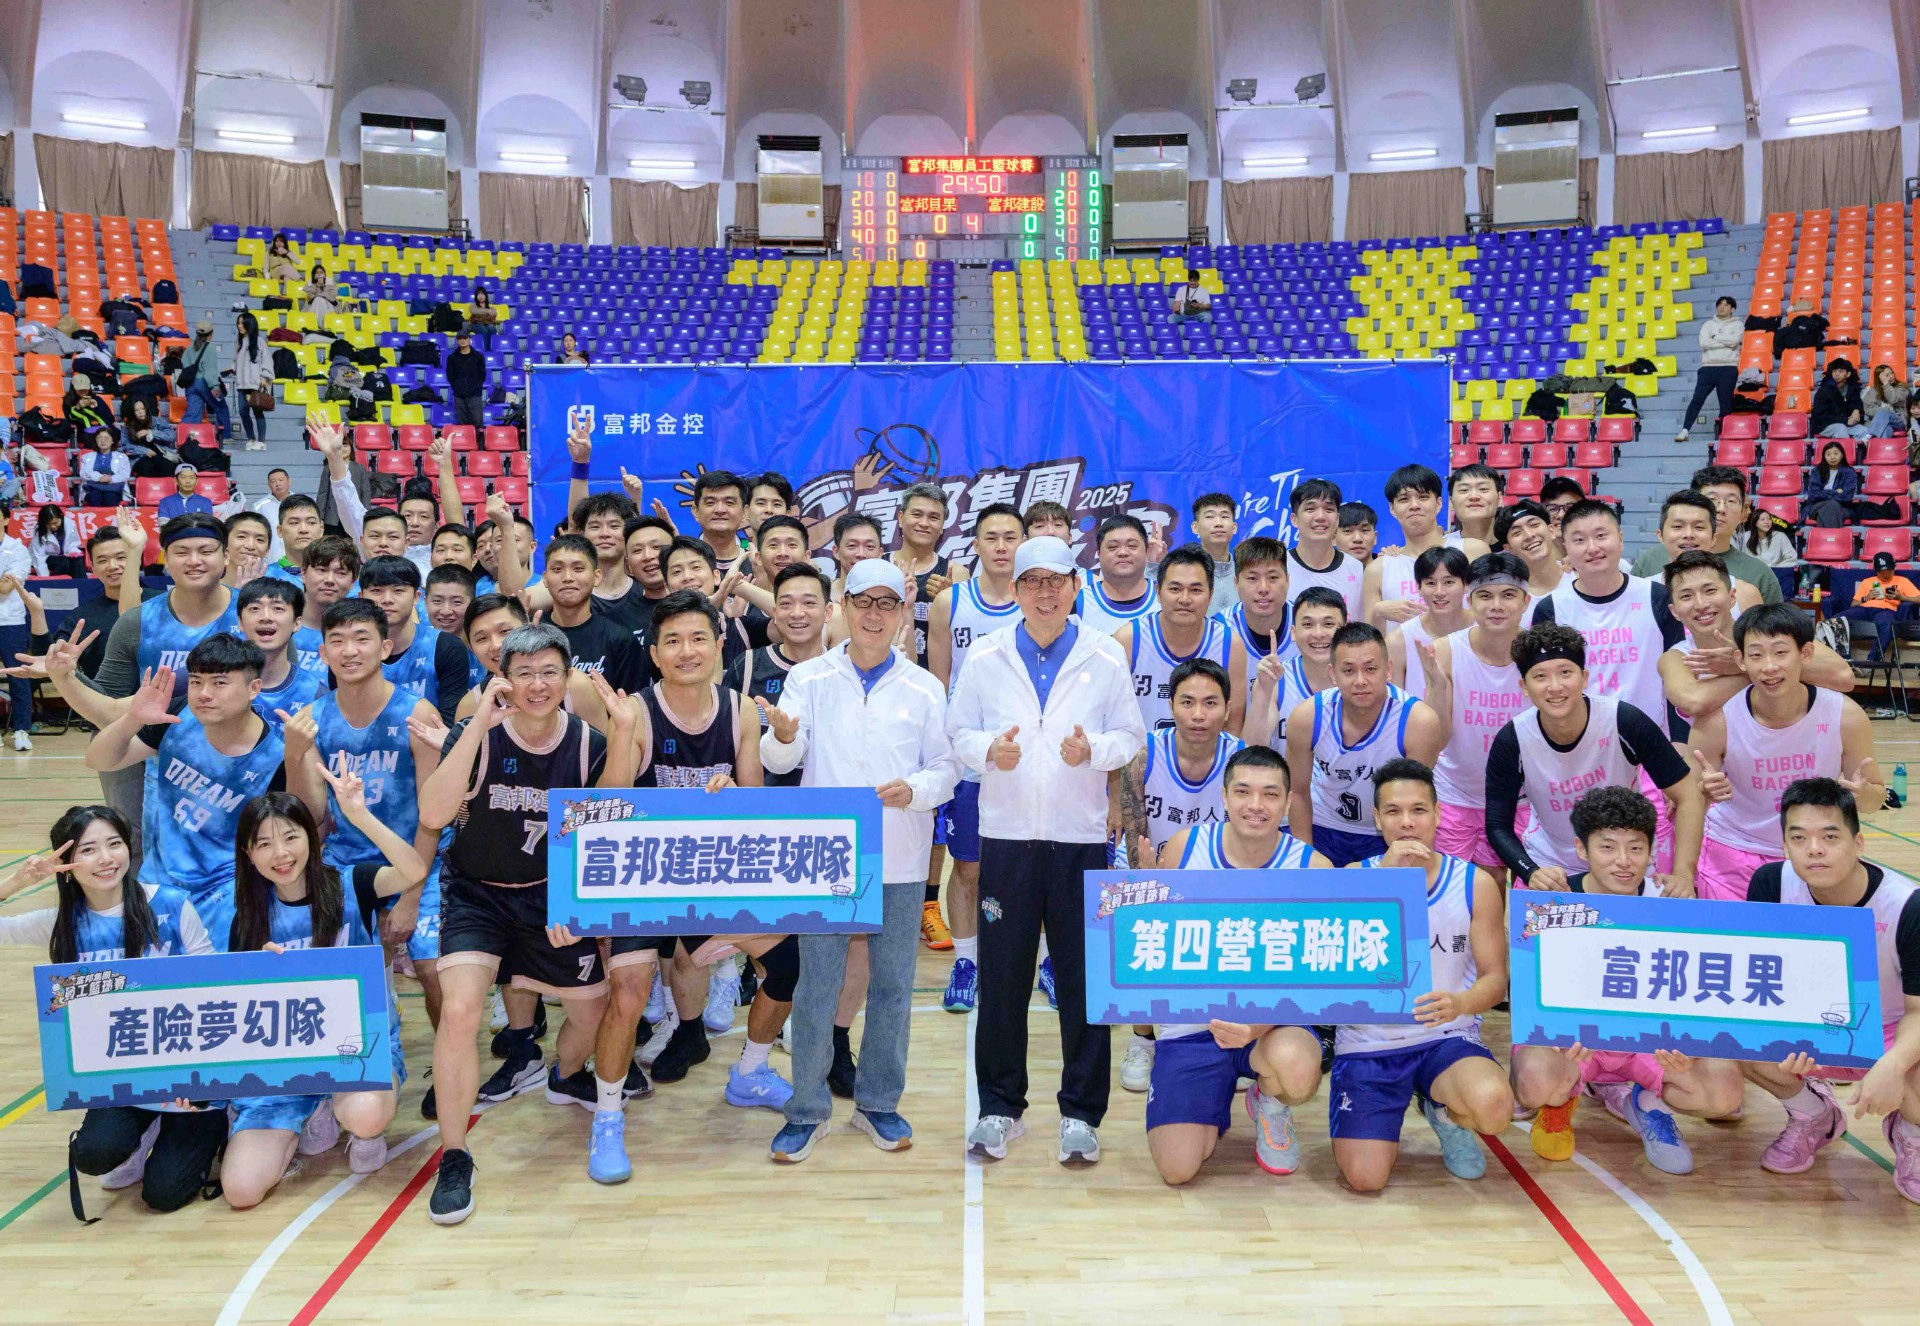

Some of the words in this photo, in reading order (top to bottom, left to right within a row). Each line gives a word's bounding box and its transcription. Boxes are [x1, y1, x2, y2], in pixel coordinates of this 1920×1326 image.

[907, 158, 1035, 173] 富邦集團員工籃球賽
[942, 175, 1001, 194] 29:50
[988, 197, 1045, 212] 富邦建設
[934, 213, 947, 233] 0
[966, 215, 978, 232] 4
[1024, 213, 1037, 233] 0
[915, 241, 926, 258] 0
[1024, 241, 1035, 258] 0
[603, 412, 704, 436] 富邦金控
[1079, 484, 1131, 511] 2025
[1581, 627, 1633, 646] UBON
[1588, 646, 1639, 666] AGELS
[1597, 671, 1619, 693] 14
[1469, 690, 1522, 708] FUBON
[1464, 709, 1512, 728] BAGEL
[1754, 752, 1816, 773] FUBON
[164, 757, 246, 813] DREAM
[1549, 765, 1607, 796] FUBON
[489, 783, 548, 813] 富邦建
[1168, 806, 1230, 824] 富邦人
[521, 819, 548, 855] 7
[581, 834, 852, 888] 富邦建設籃球隊
[1128, 917, 1390, 972] 第四營管聯隊
[579, 954, 597, 982] 7
[1601, 945, 1785, 1007] 富邦貝果
[105, 997, 326, 1058] 產險夢幻隊
